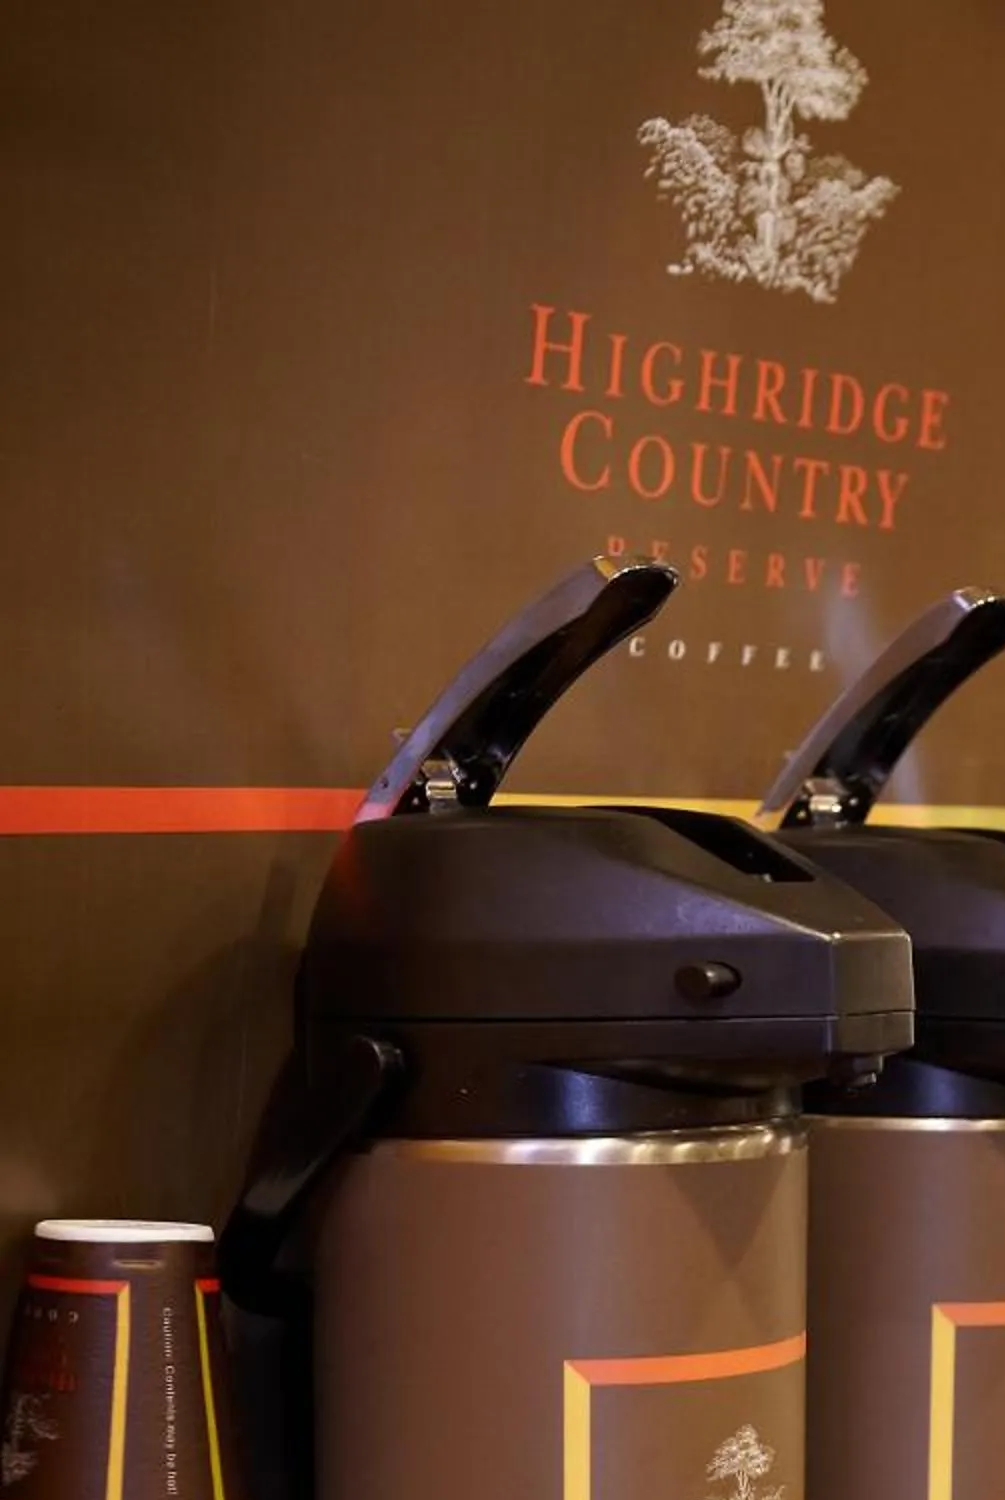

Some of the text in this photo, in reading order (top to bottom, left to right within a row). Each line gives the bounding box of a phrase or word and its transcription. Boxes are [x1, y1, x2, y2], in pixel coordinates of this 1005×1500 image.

[524, 303, 951, 451] HIGHRIDGE
[559, 410, 909, 531] COUNTRY
[628, 636, 826, 672] COFFEE
